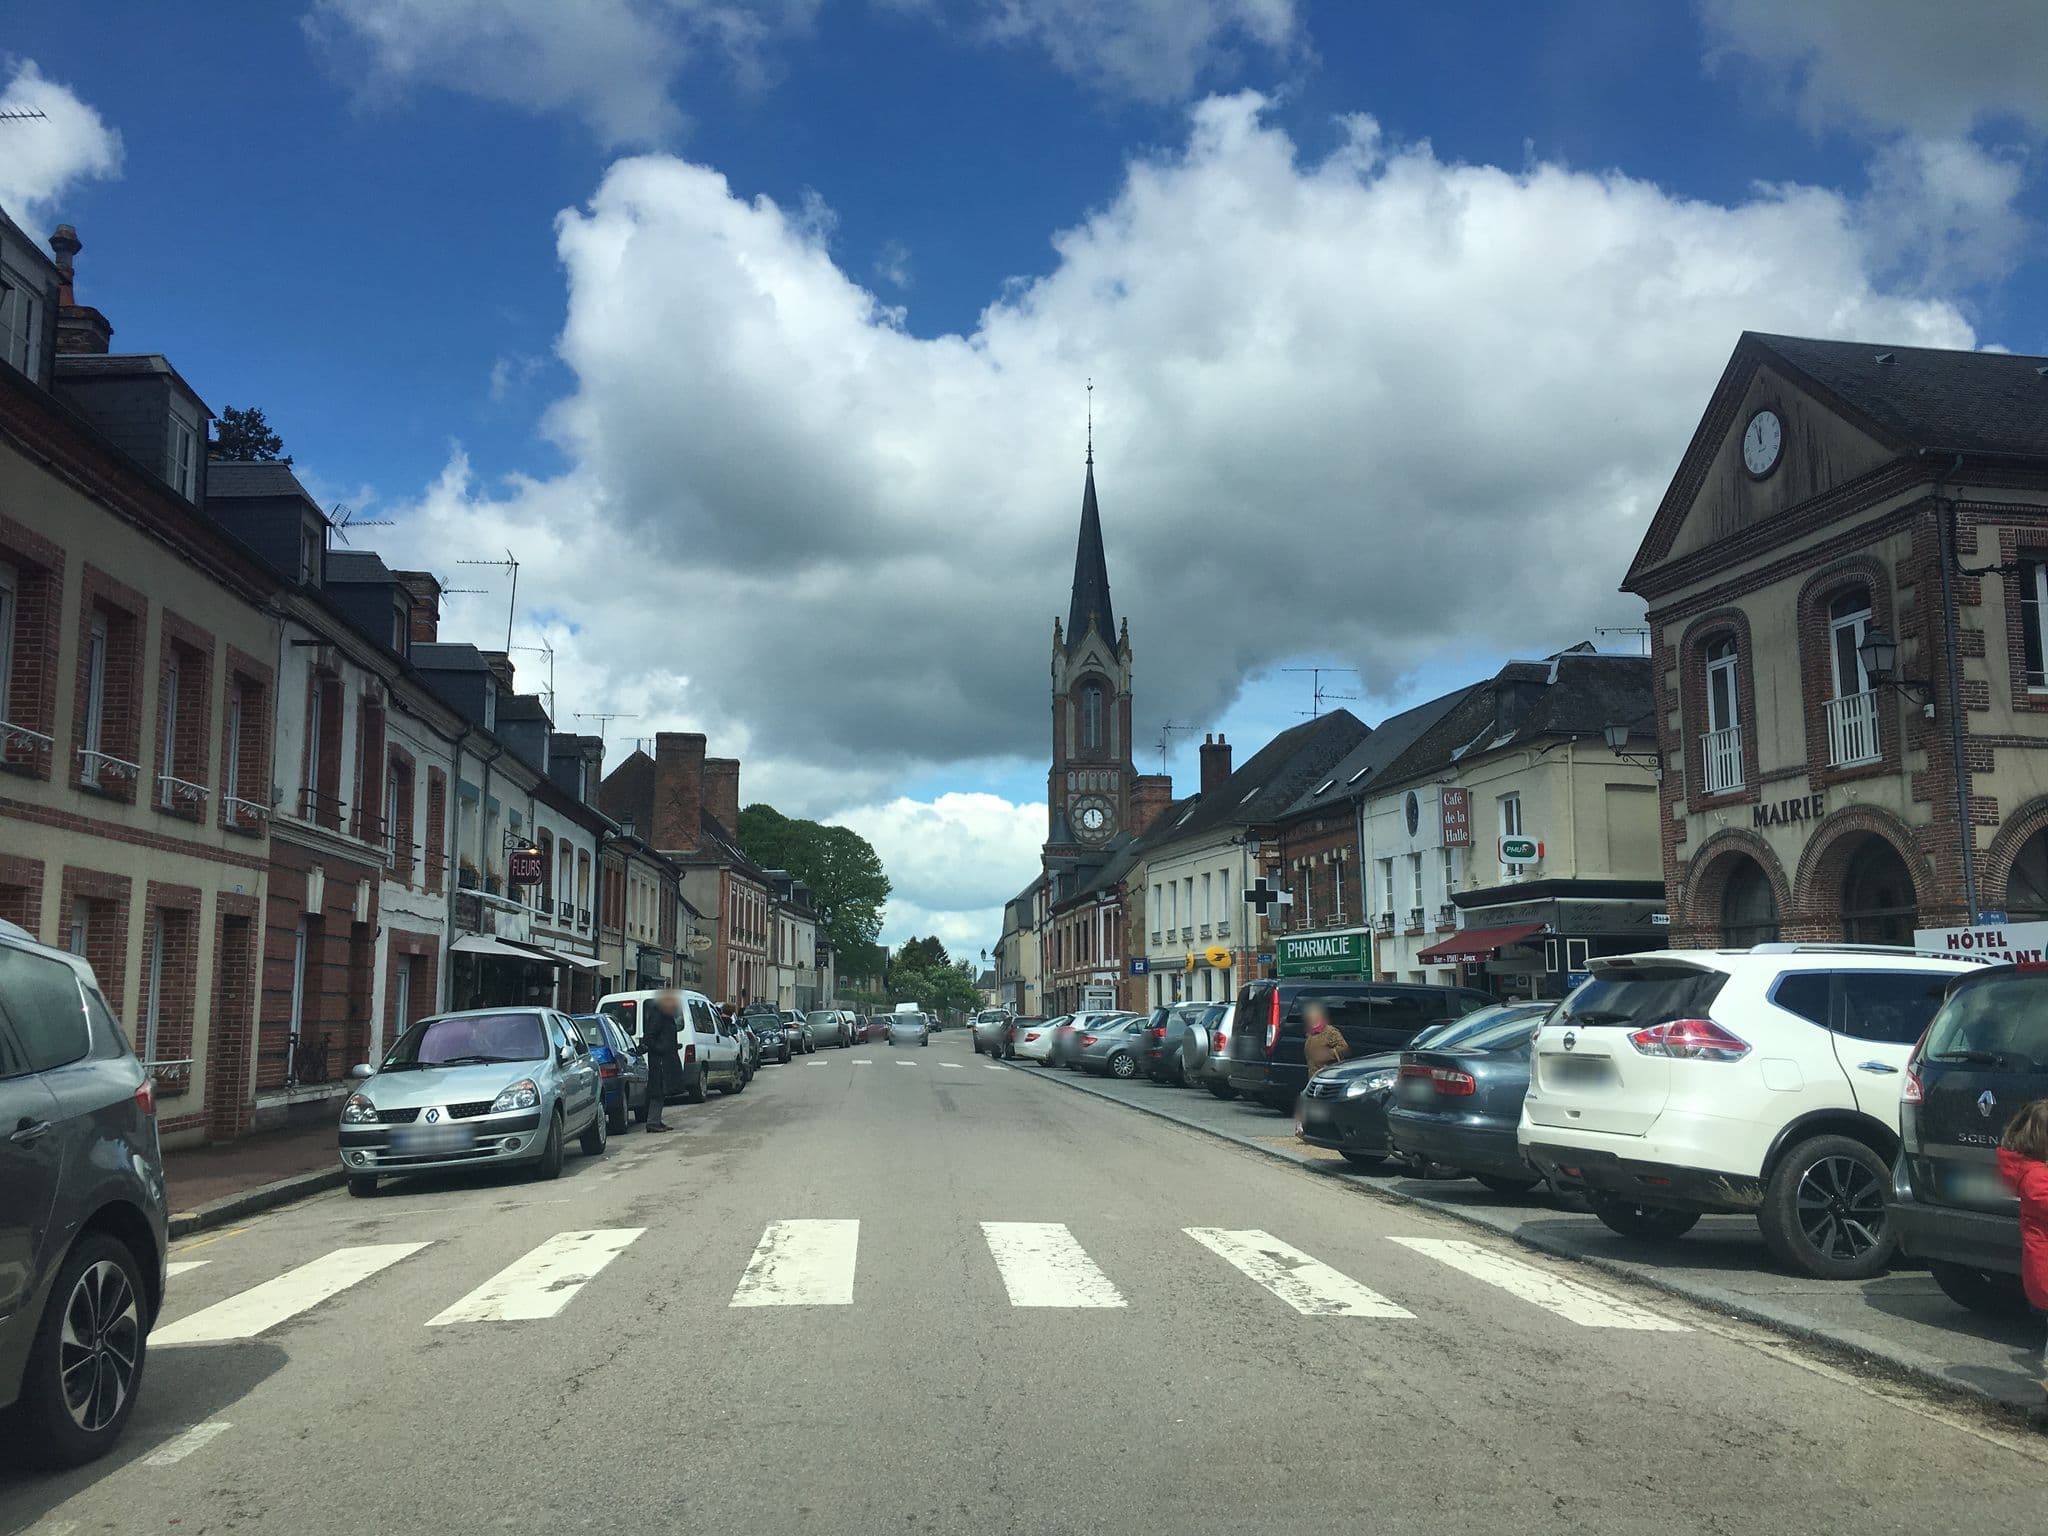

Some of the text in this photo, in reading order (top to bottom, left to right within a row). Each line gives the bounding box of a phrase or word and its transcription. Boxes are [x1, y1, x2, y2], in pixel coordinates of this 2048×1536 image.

[1443, 792, 1462, 806] Café
[1445, 810, 1466, 824] de la
[1753, 794, 1825, 827] MAIRIE
[1445, 828, 1468, 842] Halle
[512, 859, 541, 877] FLEURS
[1946, 928, 2008, 950] HÔTEL
[1287, 936, 1350, 959] PHARMACIE
[1433, 955, 1443, 963] Bar
[1446, 954, 1458, 963] PMU
[1463, 954, 1476, 962] Jeux
[1957, 1132, 1999, 1145] SCEN
